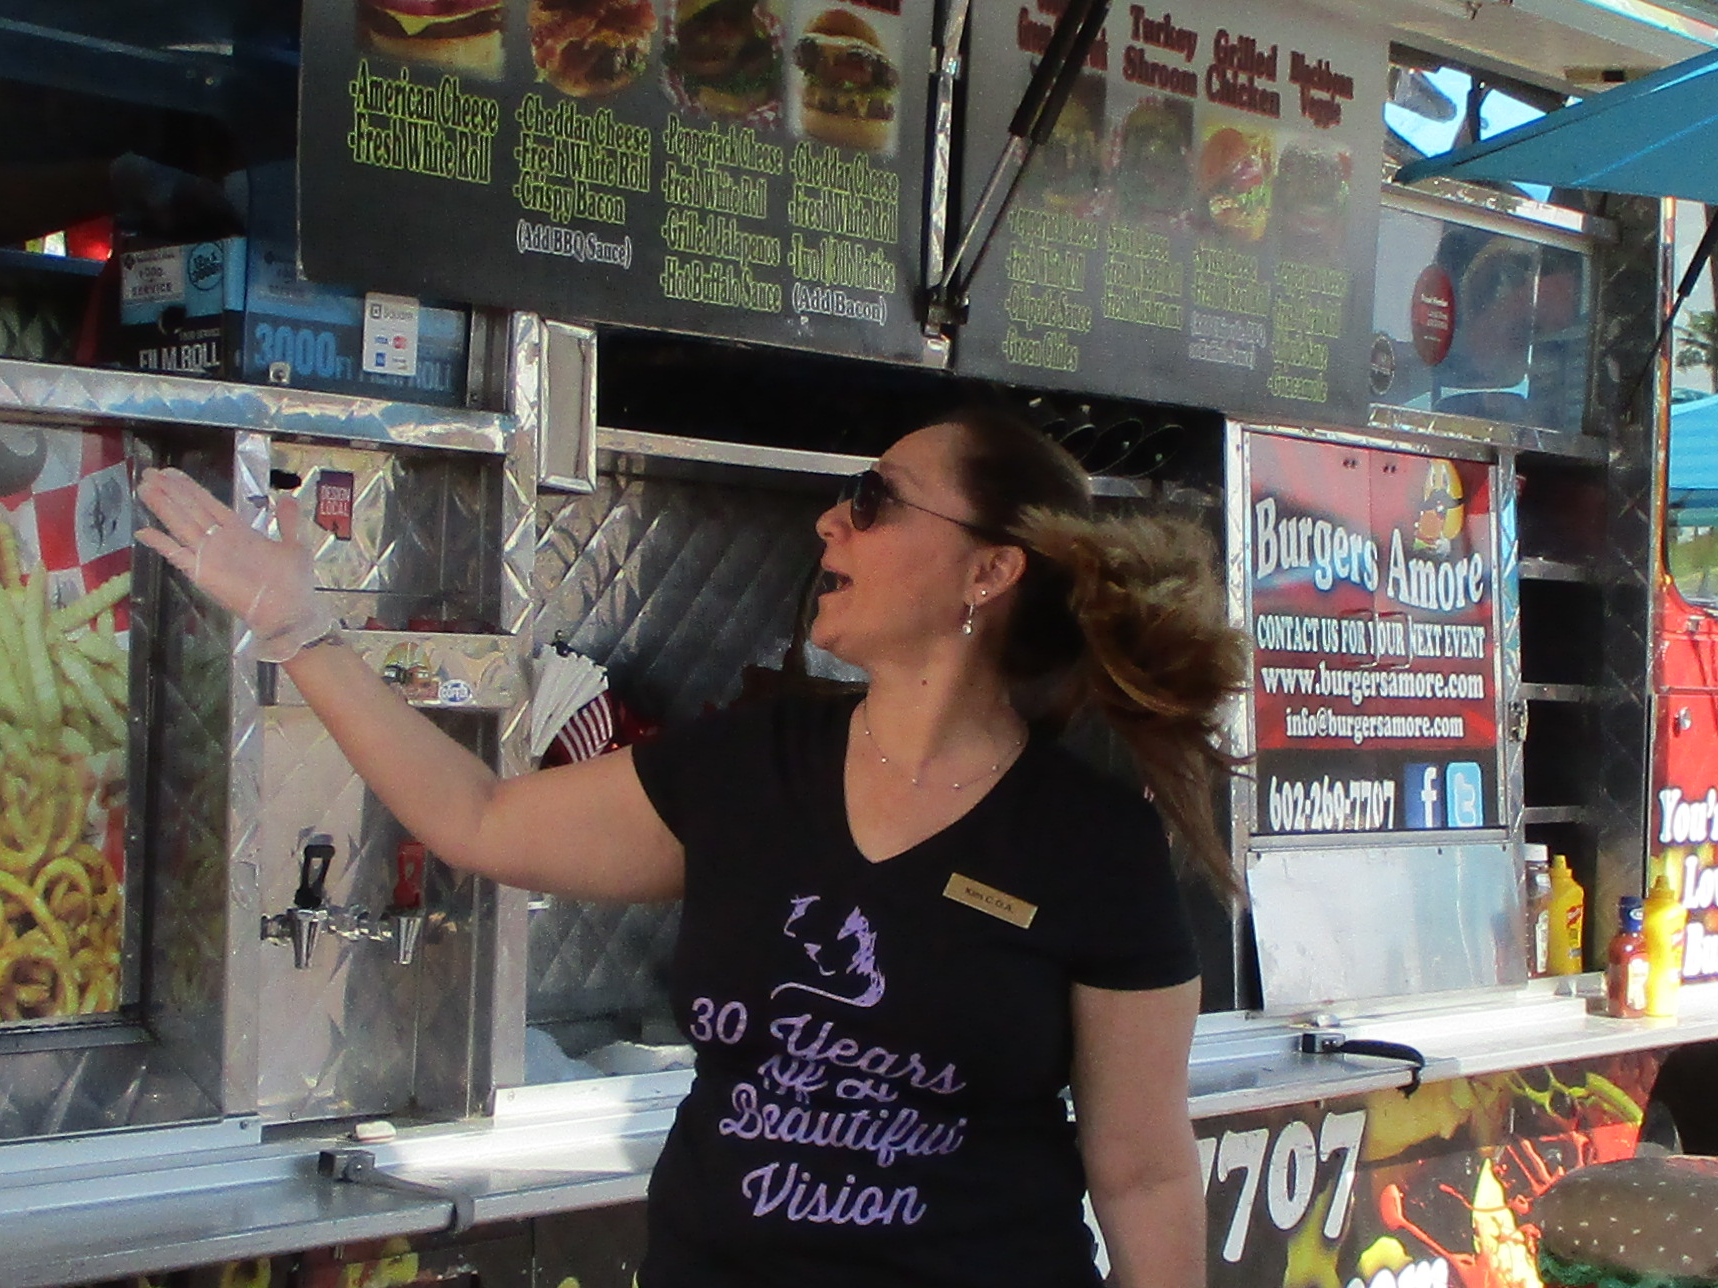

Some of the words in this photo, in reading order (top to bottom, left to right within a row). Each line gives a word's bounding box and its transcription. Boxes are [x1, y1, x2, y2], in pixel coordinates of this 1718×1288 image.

[1130, 4, 1198, 62] Turkey
[1213, 29, 1278, 82] Grilled
[1123, 45, 1198, 97] Shroom
[1206, 63, 1280, 119] Chicken
[438, 75, 499, 136] Cheese
[594, 108, 650, 154] Cheese
[405, 121, 455, 177] White
[456, 132, 492, 184] Roll
[573, 180, 625, 224] Bacon
[517, 218, 552, 254] (Add
[552, 226, 584, 262] BBQ
[584, 233, 631, 270] Sauce)
[793, 282, 833, 315] (Add
[834, 290, 886, 326] Bacon)
[183, 342, 220, 370] ROLL
[1255, 497, 1379, 592] Burgers
[1387, 528, 1483, 612] Amore
[1256, 615, 1320, 653] CONTACT
[1321, 617, 1339, 654] US
[1340, 619, 1365, 655] FOR
[1409, 619, 1442, 658] NEXT
[1443, 625, 1485, 659] EVENT
[1260, 662, 1484, 706] www.burgersamore.com
[1286, 707, 1464, 745] info@burgersamore.com
[1269, 775, 1396, 831] 602-269-7707
[688, 997, 748, 1044] 30
[770, 1014, 966, 1096] Years
[741, 1161, 928, 1227] Vision
